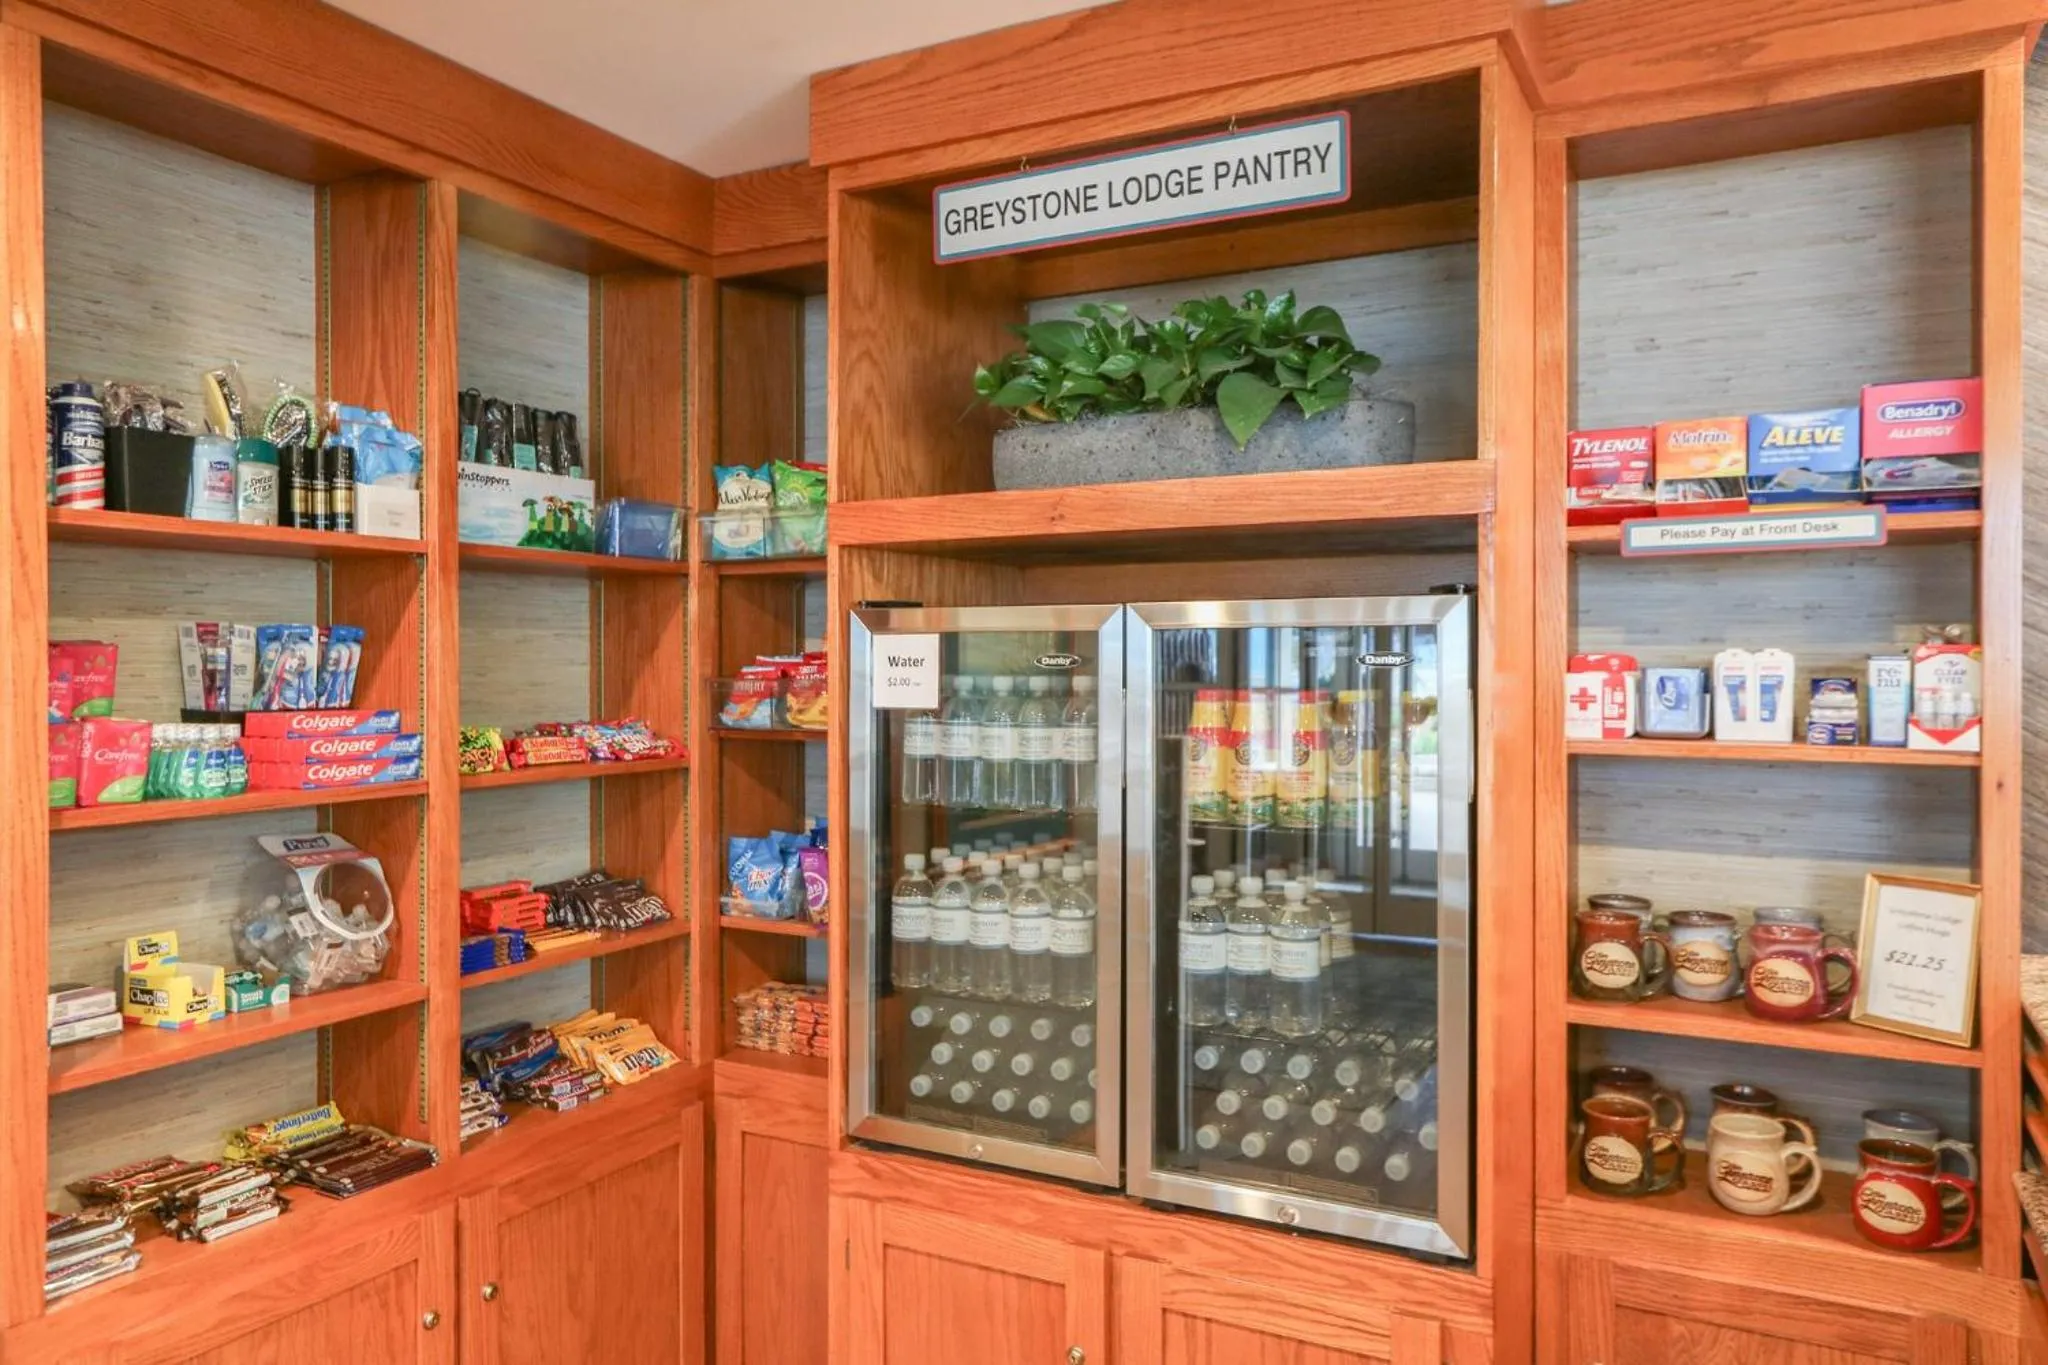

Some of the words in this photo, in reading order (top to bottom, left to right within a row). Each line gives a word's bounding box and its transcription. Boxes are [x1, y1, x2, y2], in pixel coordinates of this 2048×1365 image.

[945, 184, 1098, 236] GREYSTONE
[1107, 165, 1204, 208] LODGE
[1213, 142, 1333, 191] PANTRY
[1885, 401, 1957, 419] Benadryl
[1762, 426, 1845, 447] ALEVE
[1888, 424, 1954, 439] ALLERGY
[1572, 437, 1649, 456] TYLENOL
[1660, 525, 1706, 540] Please
[1711, 524, 1737, 539] Pay
[1741, 525, 1755, 536] at
[1759, 522, 1798, 534] Front
[1802, 520, 1839, 533] Desk
[888, 656, 925, 667] Water
[1365, 654, 1403, 666] Danby
[887, 677, 911, 688] $2.00
[292, 714, 357, 731] Colgate
[310, 739, 376, 756] Colgate
[307, 765, 374, 781] Colgate
[1884, 950, 1946, 971] $21.25
